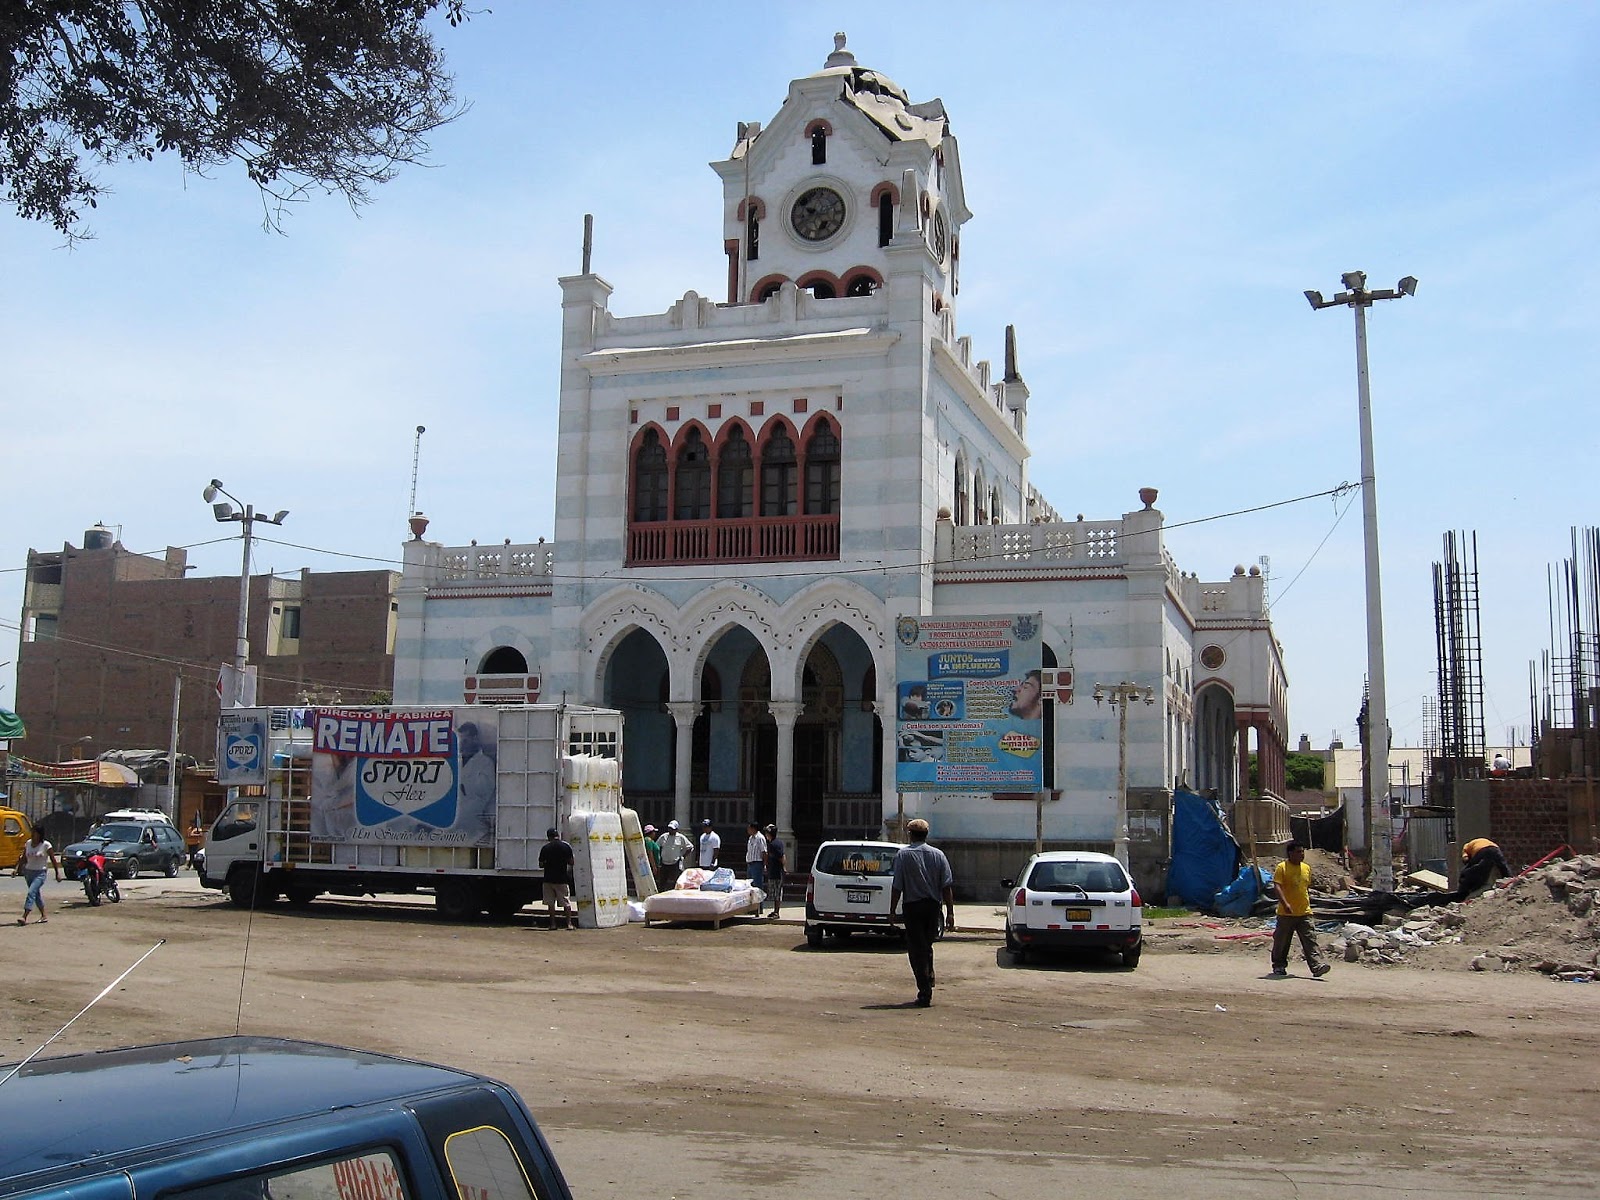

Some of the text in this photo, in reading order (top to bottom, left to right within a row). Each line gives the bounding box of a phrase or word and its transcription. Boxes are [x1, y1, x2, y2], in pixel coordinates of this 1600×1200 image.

[938, 654, 974, 663] JUNTOS
[320, 707, 452, 720] DIRECTO DE FABRICA
[317, 717, 451, 754] REMATE
[228, 745, 254, 755] SPORT
[363, 760, 445, 784] SPORT
